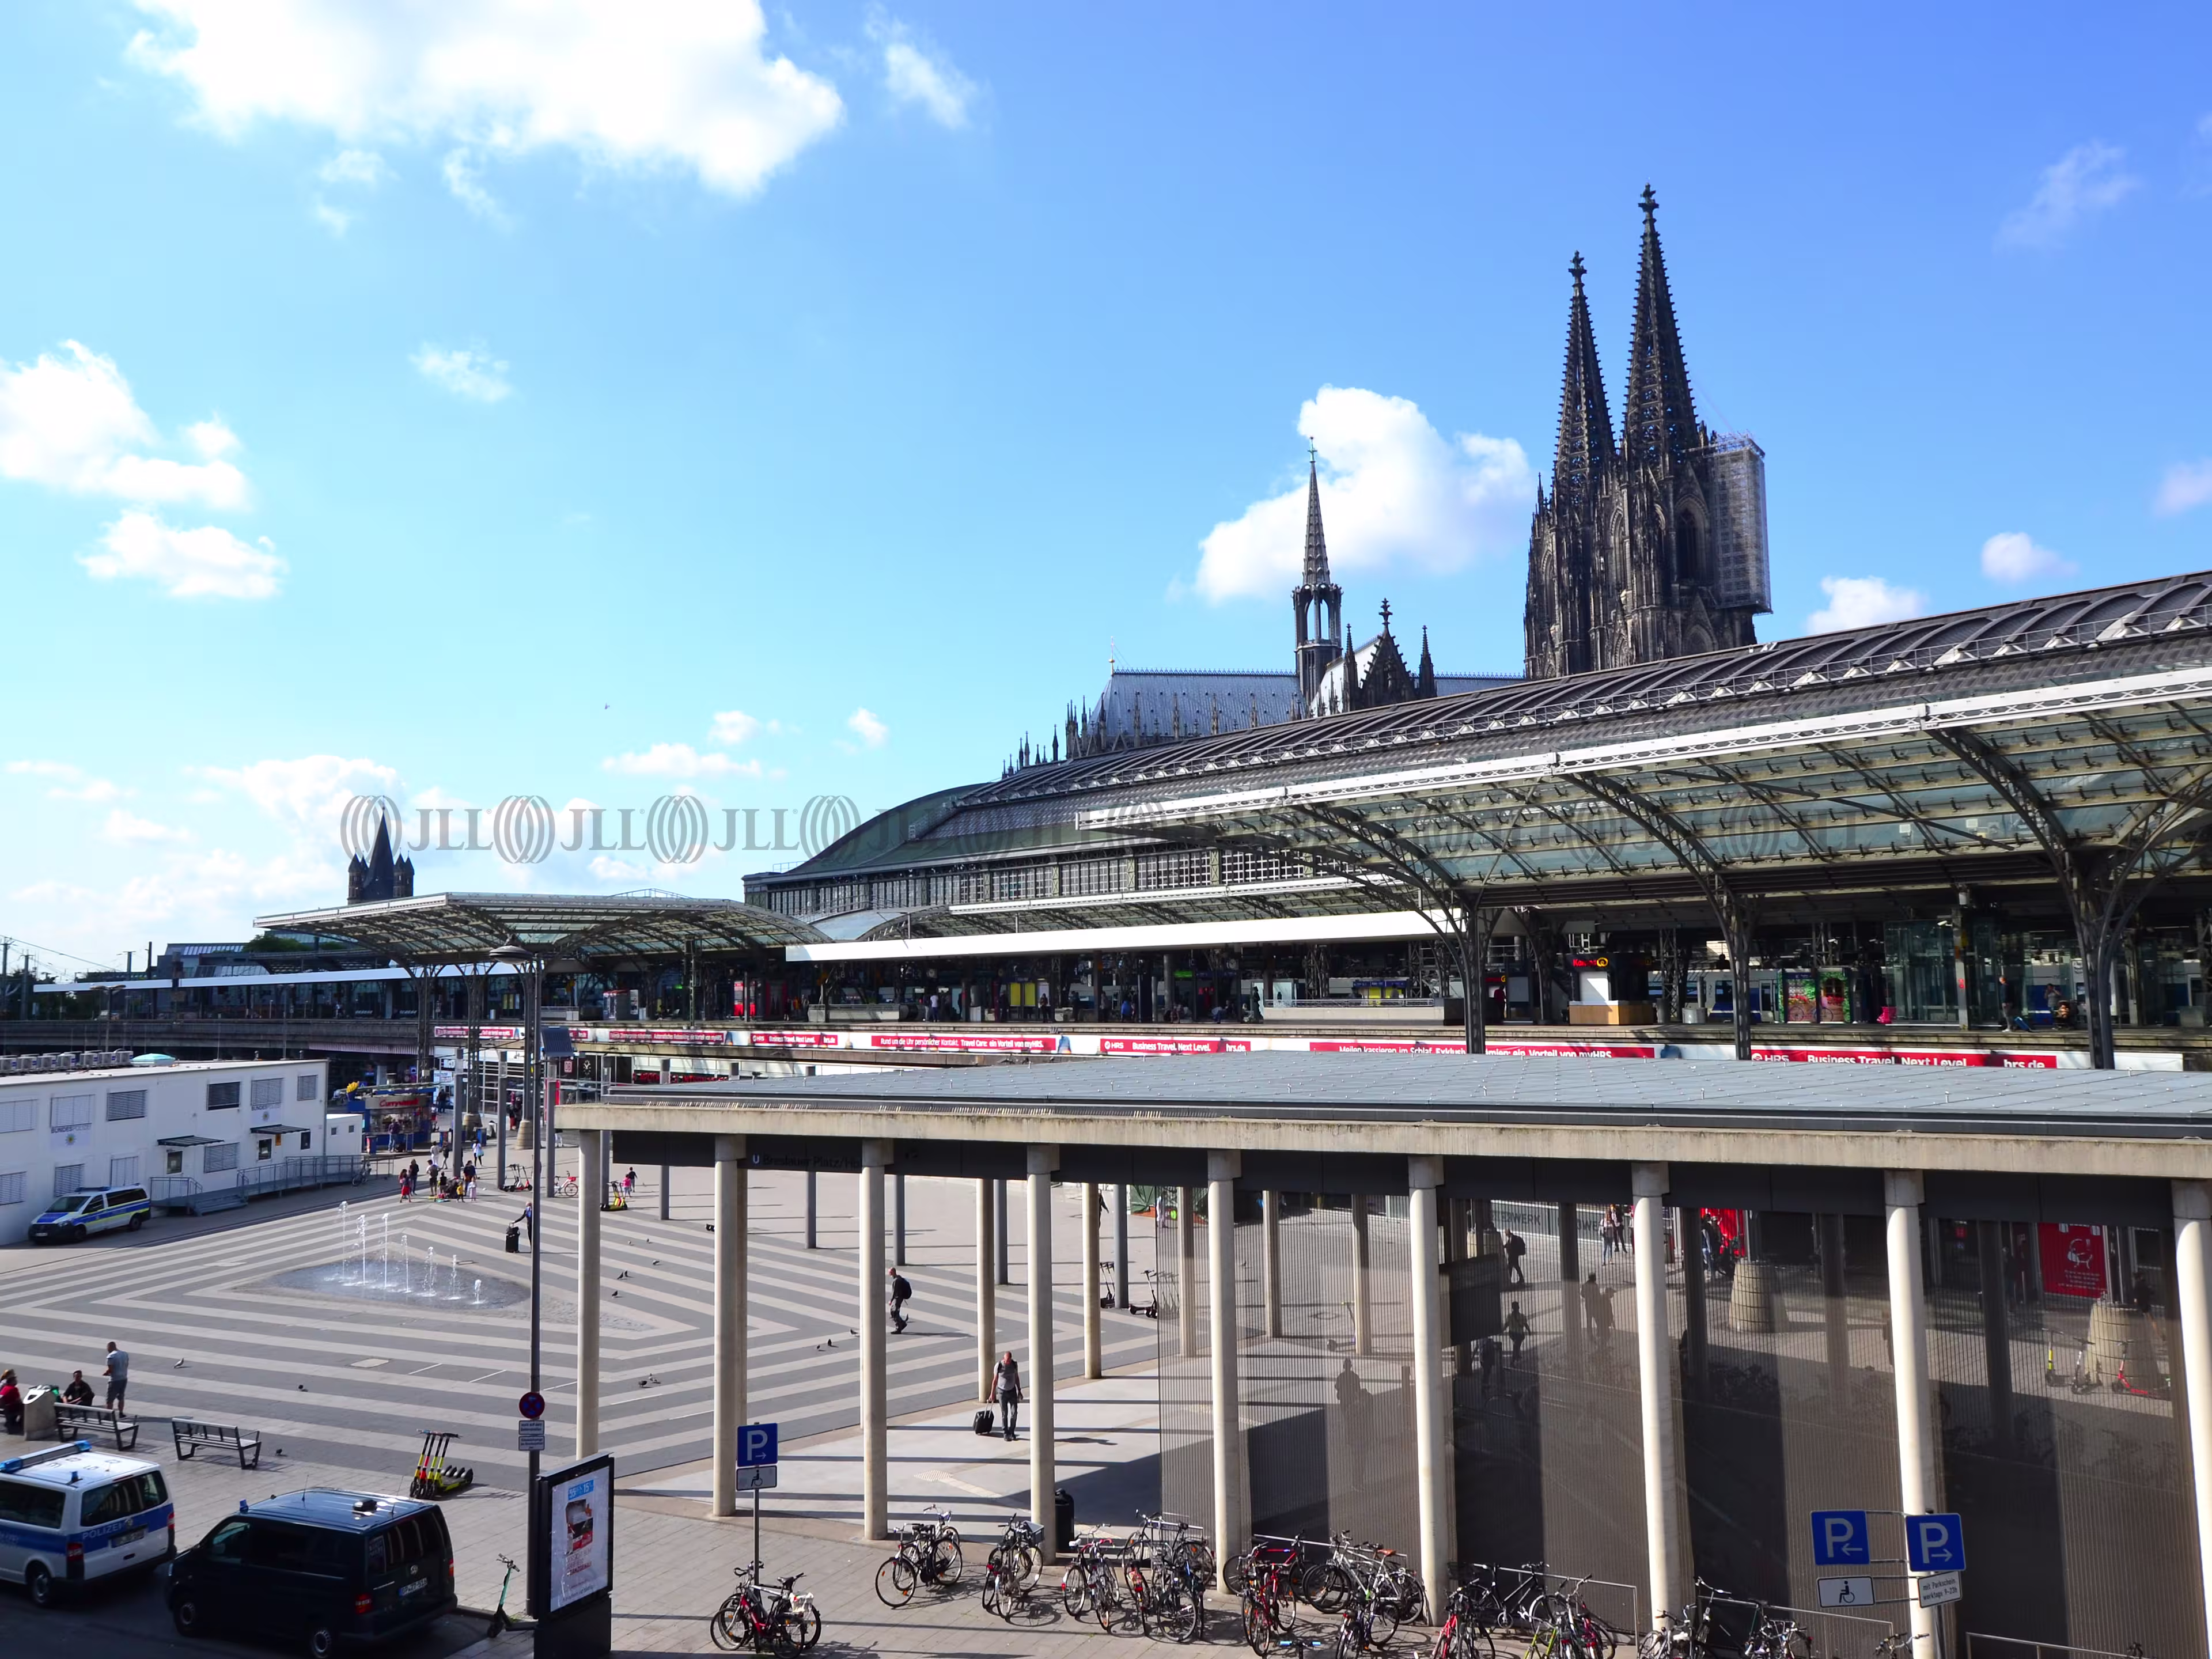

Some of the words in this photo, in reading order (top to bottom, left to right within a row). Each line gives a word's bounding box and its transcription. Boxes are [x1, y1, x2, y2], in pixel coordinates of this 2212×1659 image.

[915, 1039, 940, 1047] persönlicher
[1132, 1042, 1157, 1051] Business
[1157, 1043, 1176, 1051] Travel.
[1178, 1043, 1192, 1051] Next
[1193, 1043, 1211, 1052] Level.
[1764, 1054, 1789, 1062] HRS
[1807, 1055, 1855, 1064] Business
[1901, 1057, 1931, 1066] Next
[2003, 1059, 2046, 1069] hrsde
[747, 1430, 768, 1461] P
[82, 1523, 122, 1540] POLIZEI
[1825, 1518, 1854, 1558] P
[1919, 1522, 1949, 1564] P
[1932, 1578, 1955, 1589] Parkschein
